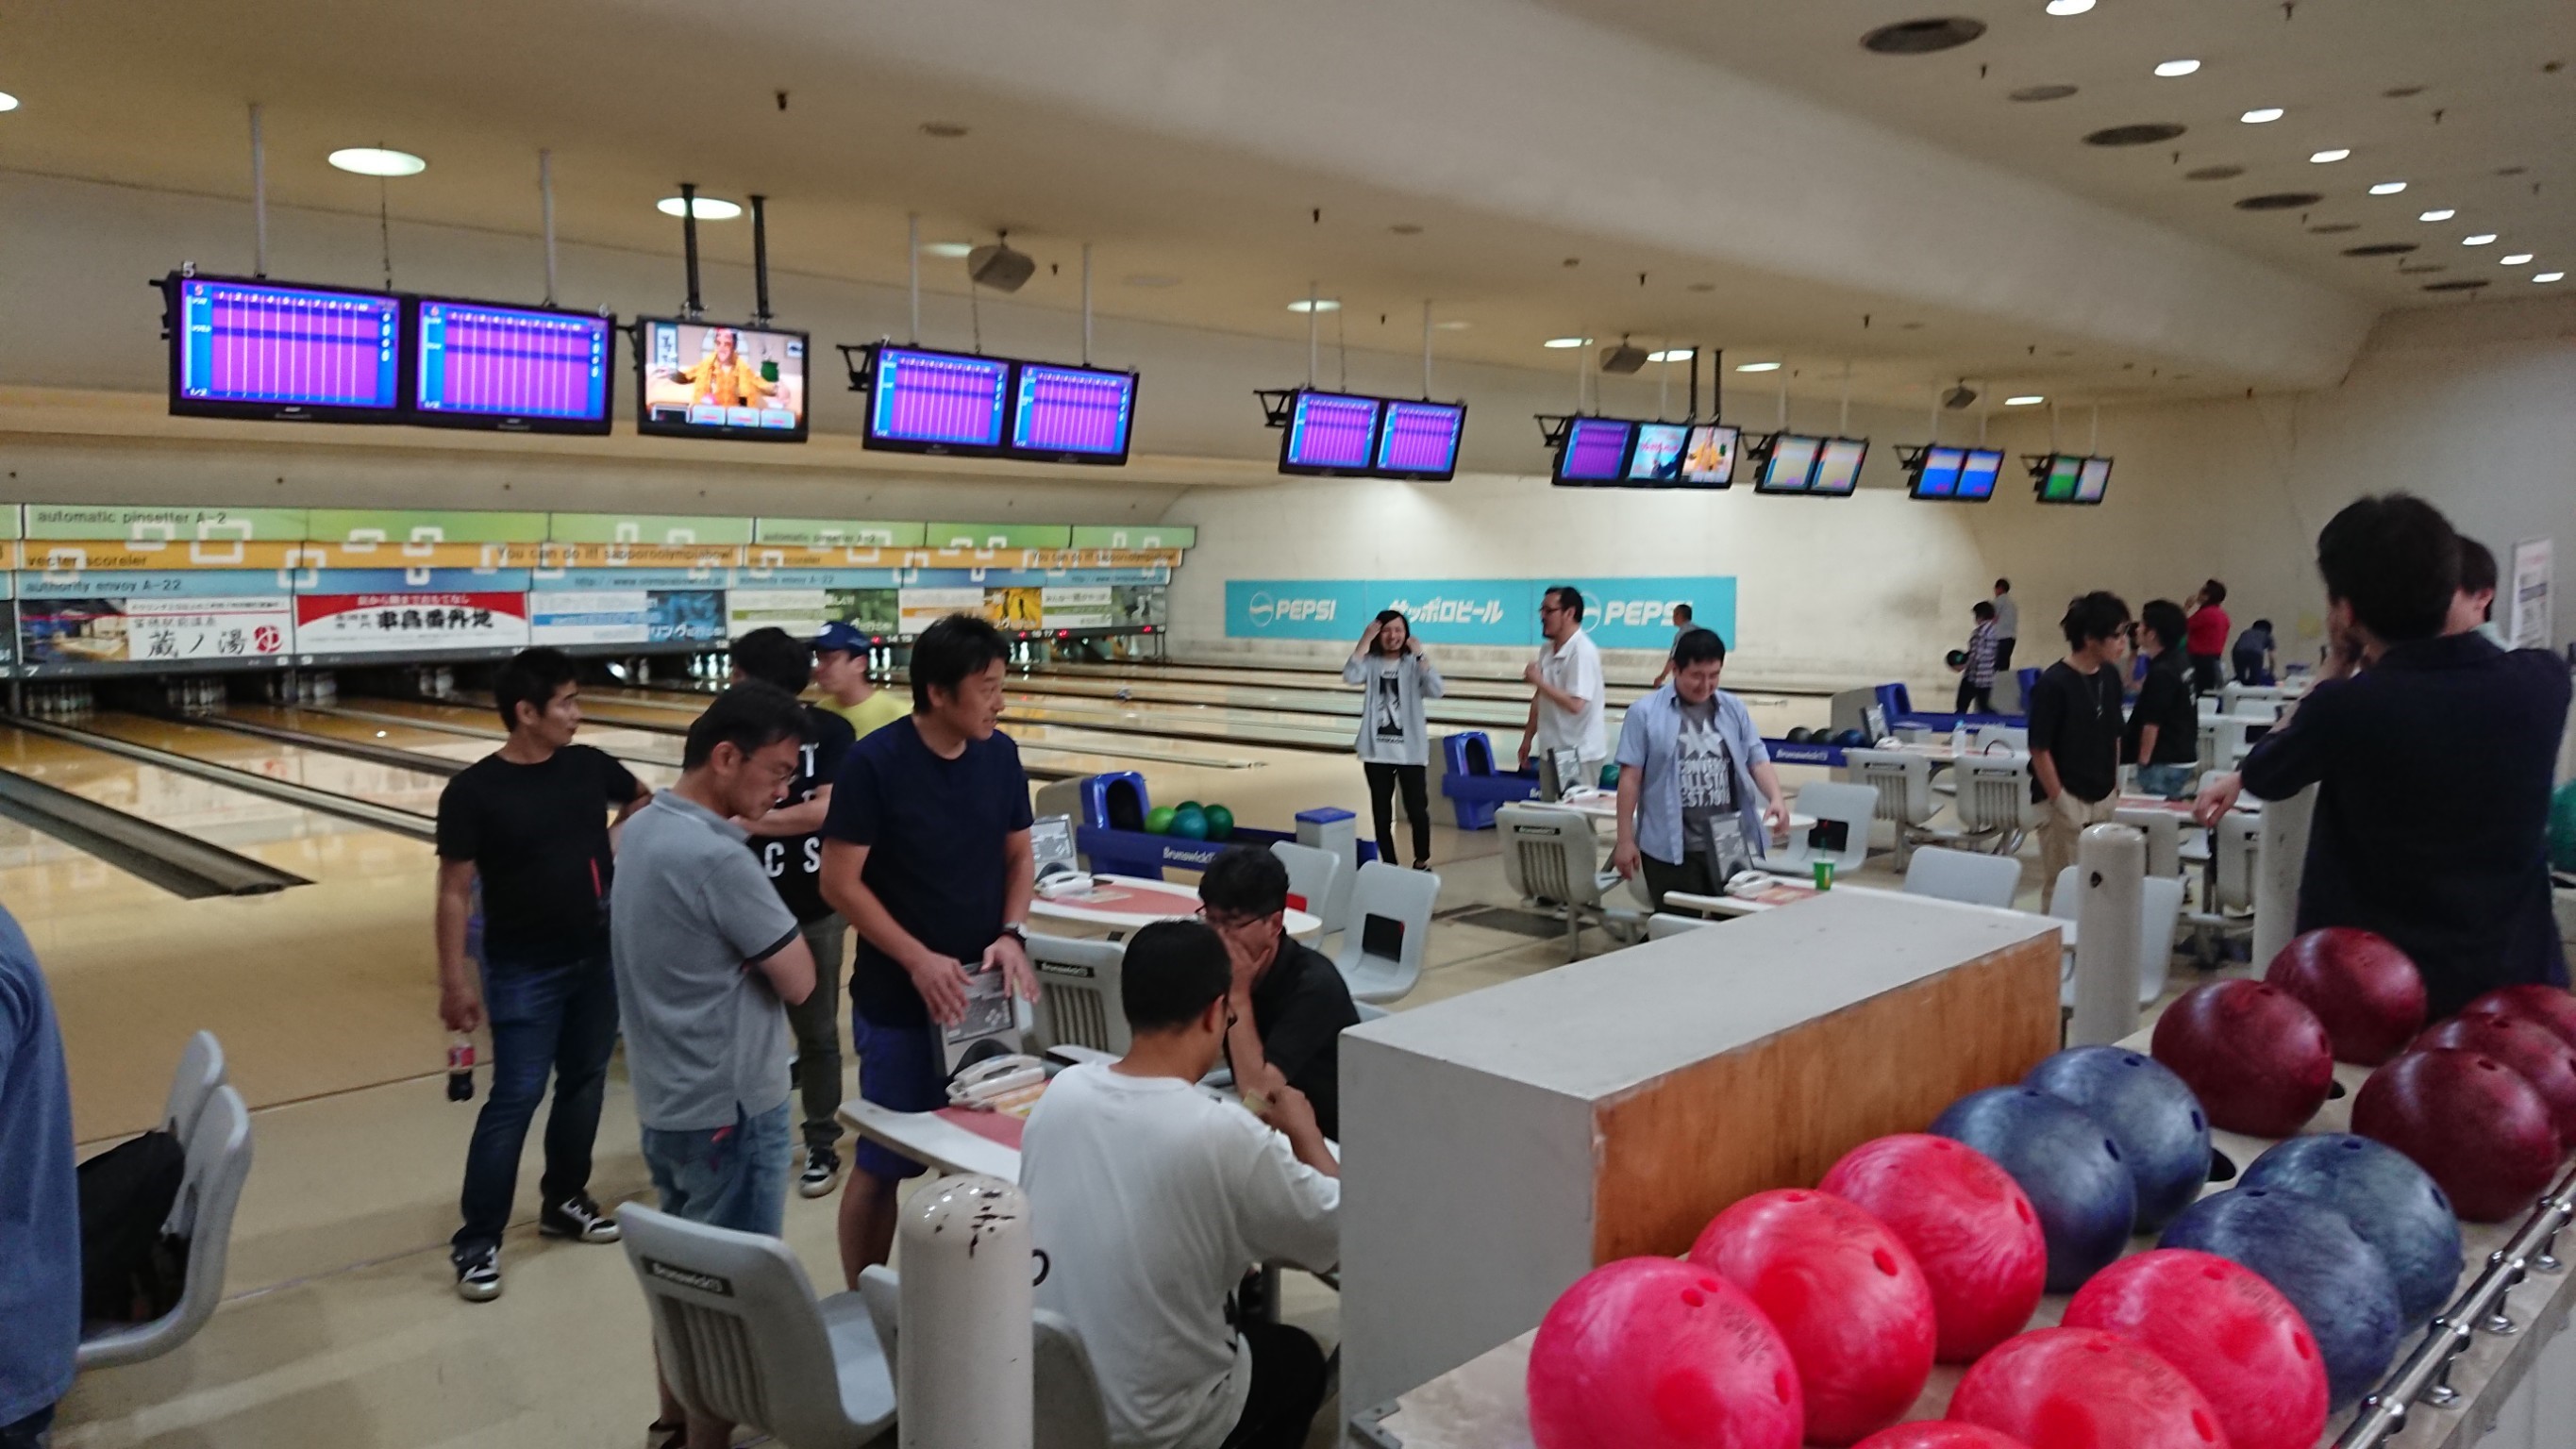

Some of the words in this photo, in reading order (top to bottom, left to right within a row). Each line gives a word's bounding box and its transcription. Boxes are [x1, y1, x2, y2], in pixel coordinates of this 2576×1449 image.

[182, 261, 196, 278] 5
[38, 511, 115, 524] automatic
[123, 511, 190, 525] pinsetter
[1275, 599, 1336, 622] PEPSI
[1604, 599, 1693, 626] PEPS
[25, 665, 40, 677] 7
[1163, 845, 1211, 864] Brunswick
